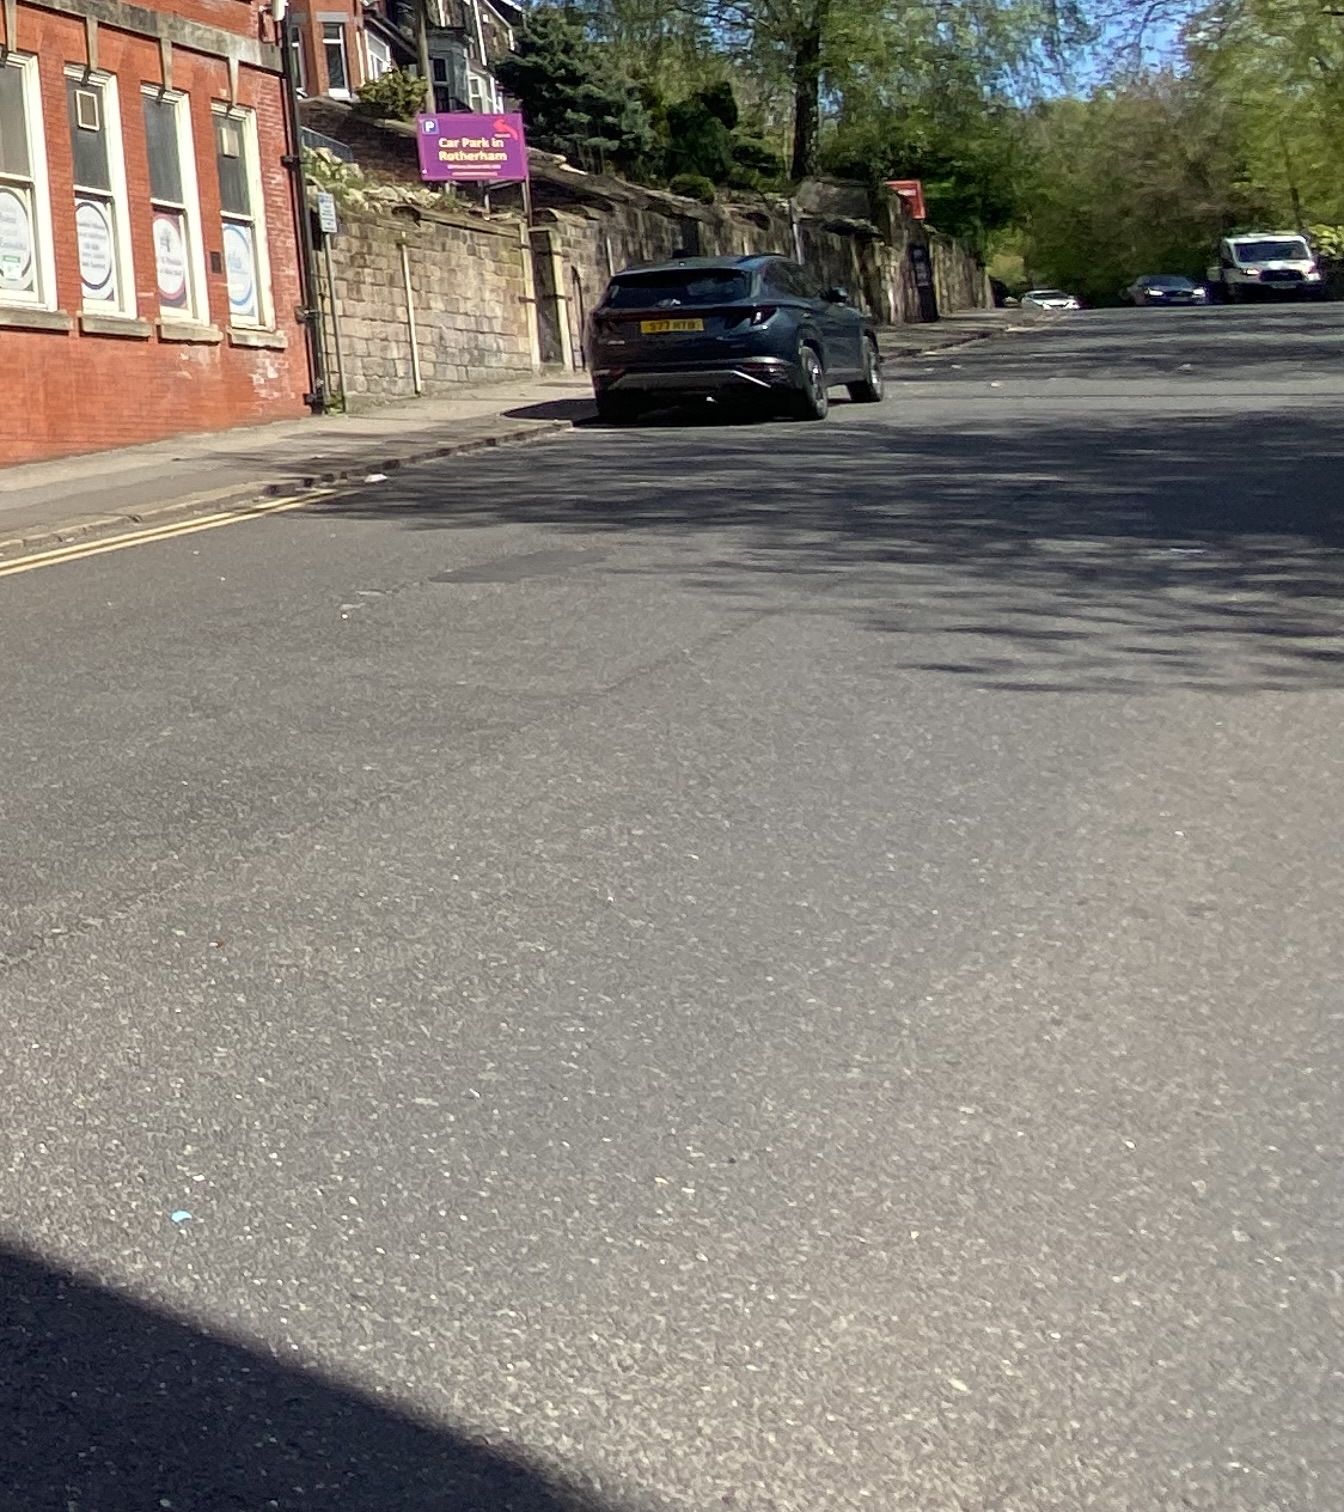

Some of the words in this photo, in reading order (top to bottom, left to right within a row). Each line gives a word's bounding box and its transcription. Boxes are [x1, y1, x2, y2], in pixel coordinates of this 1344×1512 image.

[425, 121, 435, 133] P
[438, 137, 460, 148] Car
[462, 137, 490, 148] Park
[491, 137, 504, 148] in
[438, 150, 508, 161] Rotherham
